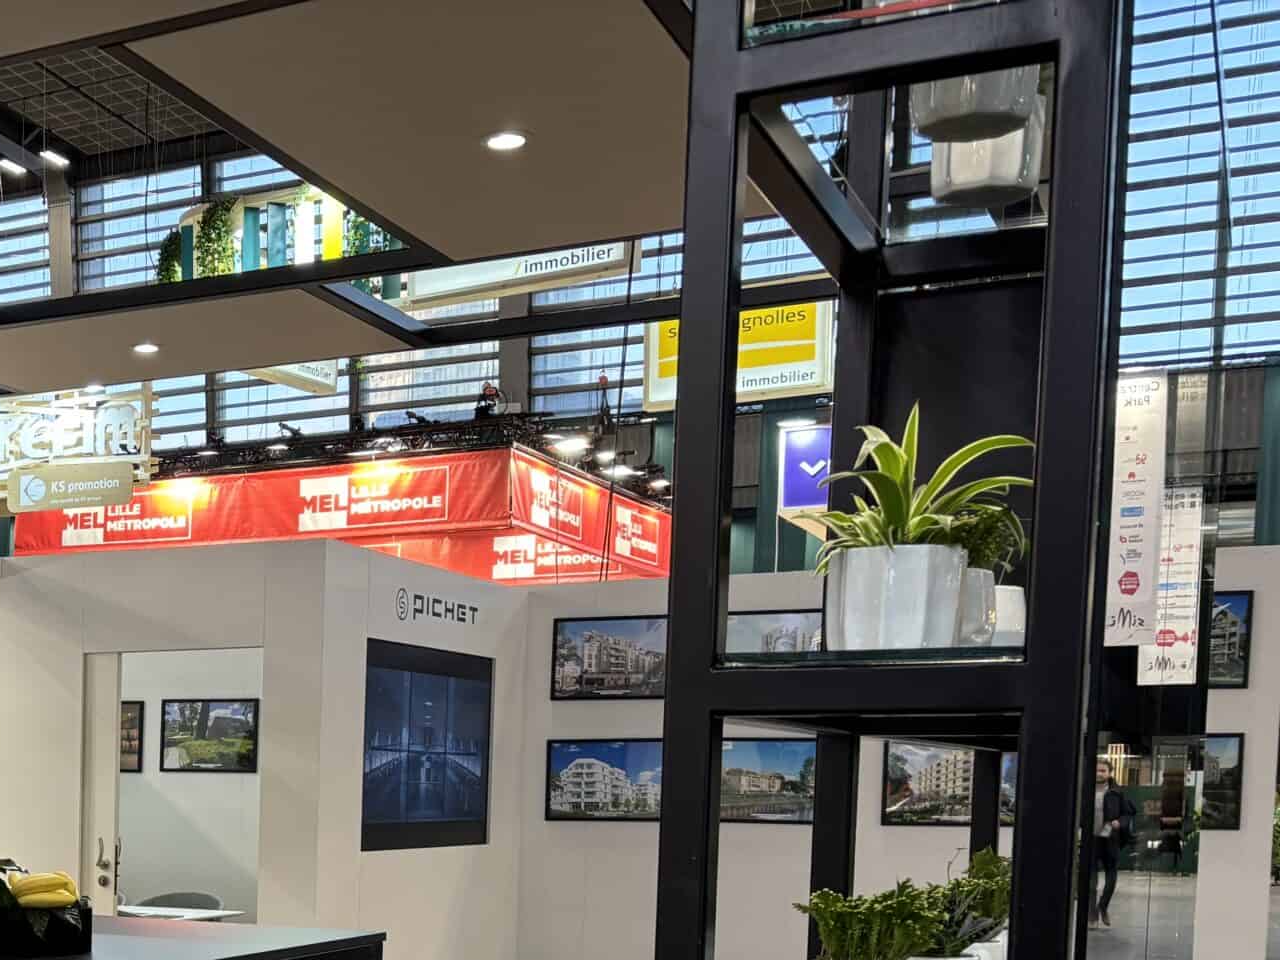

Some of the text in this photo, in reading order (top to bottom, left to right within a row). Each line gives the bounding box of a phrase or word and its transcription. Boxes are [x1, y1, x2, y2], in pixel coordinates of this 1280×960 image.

[741, 309, 807, 332] gnolles
[741, 370, 815, 388] immobilier
[51, 478, 120, 493] KS promotion
[351, 484, 389, 499] LILLE
[107, 504, 141, 517] LILLE
[301, 493, 347, 513] MEL
[350, 496, 442, 514] MÉTROPOLE
[63, 511, 105, 530] MEL
[107, 516, 187, 532] MÉTROPOLE
[495, 549, 535, 564] MEL
[413, 594, 478, 624] PICHET
